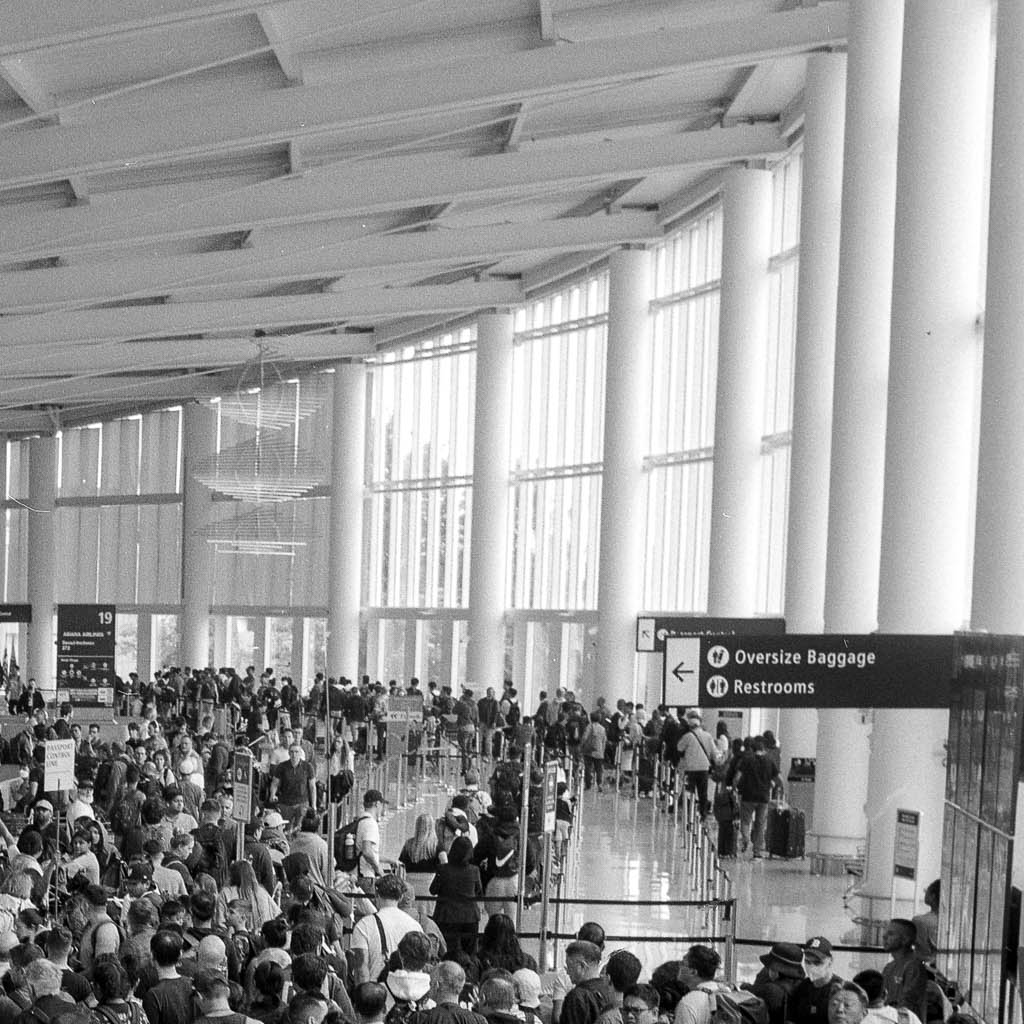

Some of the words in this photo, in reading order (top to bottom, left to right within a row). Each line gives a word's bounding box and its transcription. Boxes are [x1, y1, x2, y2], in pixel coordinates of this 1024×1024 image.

[98, 611, 113, 625] 19
[734, 649, 802, 665] Oversize
[807, 649, 876, 669] Baggage
[733, 679, 816, 695] Restrooms
